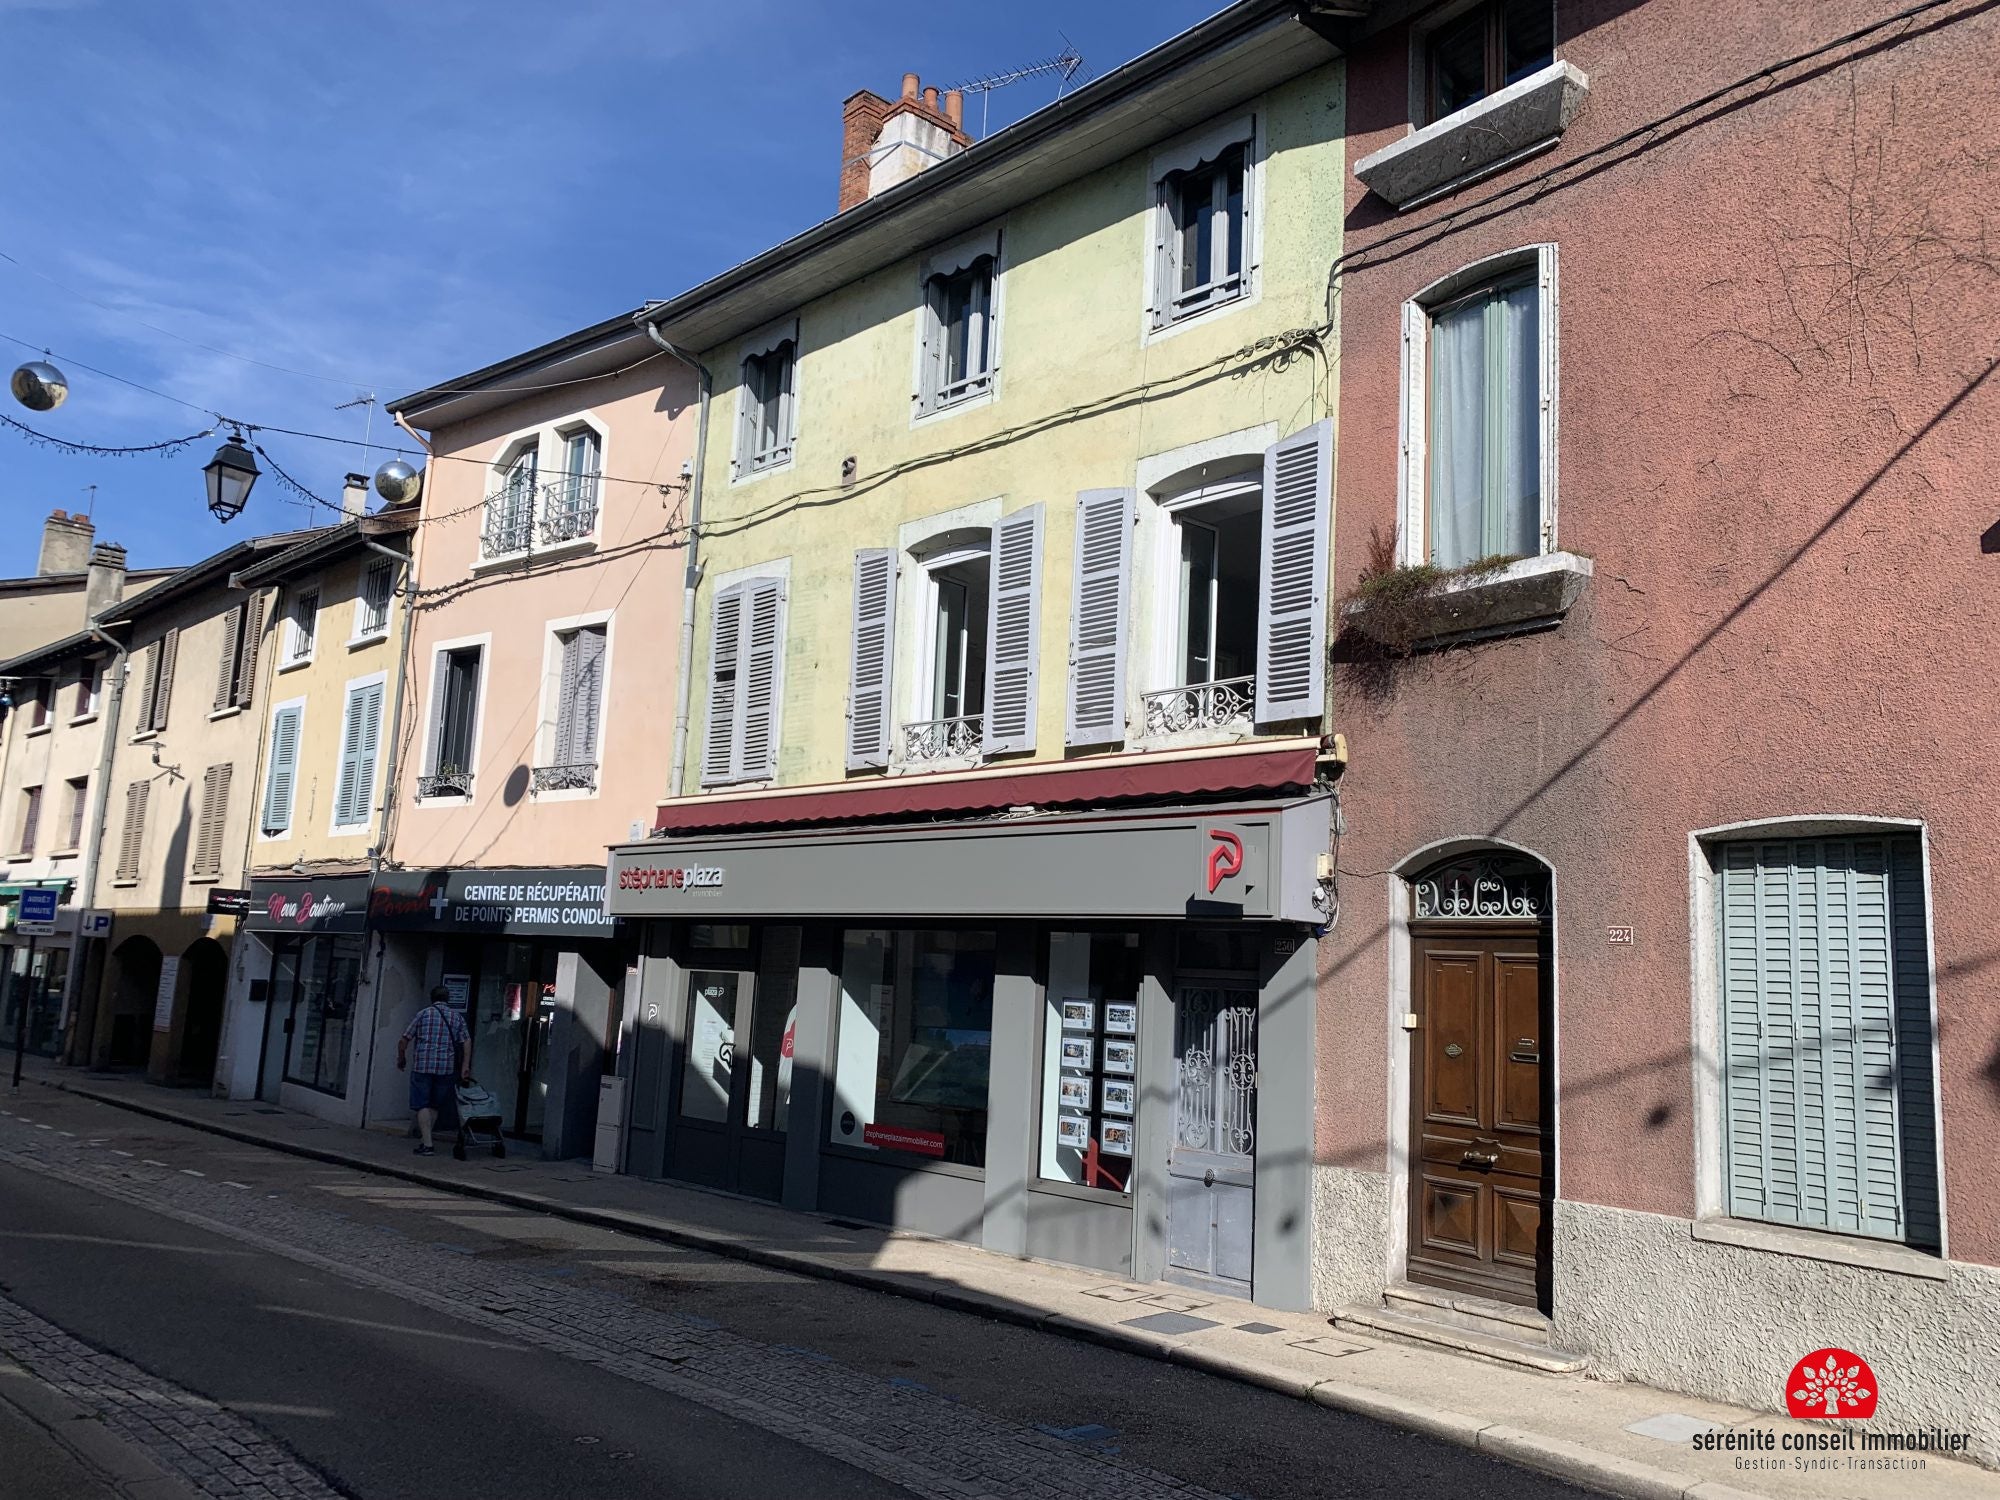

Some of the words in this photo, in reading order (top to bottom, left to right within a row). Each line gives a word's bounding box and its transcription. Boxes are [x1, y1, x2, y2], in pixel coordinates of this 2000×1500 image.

[27, 895, 51, 903] ARRÊT
[464, 885, 507, 901] CENTRE
[509, 886, 524, 901] DE
[526, 881, 605, 902] RÉCUPÉRATIO
[23, 906, 52, 915] MINUTE
[296, 892, 346, 929] Boutique
[455, 906, 469, 921] DE
[471, 906, 512, 923] POINTS
[514, 907, 559, 924] PERMIS
[94, 916, 109, 931] P
[1609, 929, 1630, 942] 224
[865, 1130, 943, 1149] stephaneplazaimmobilier.com
